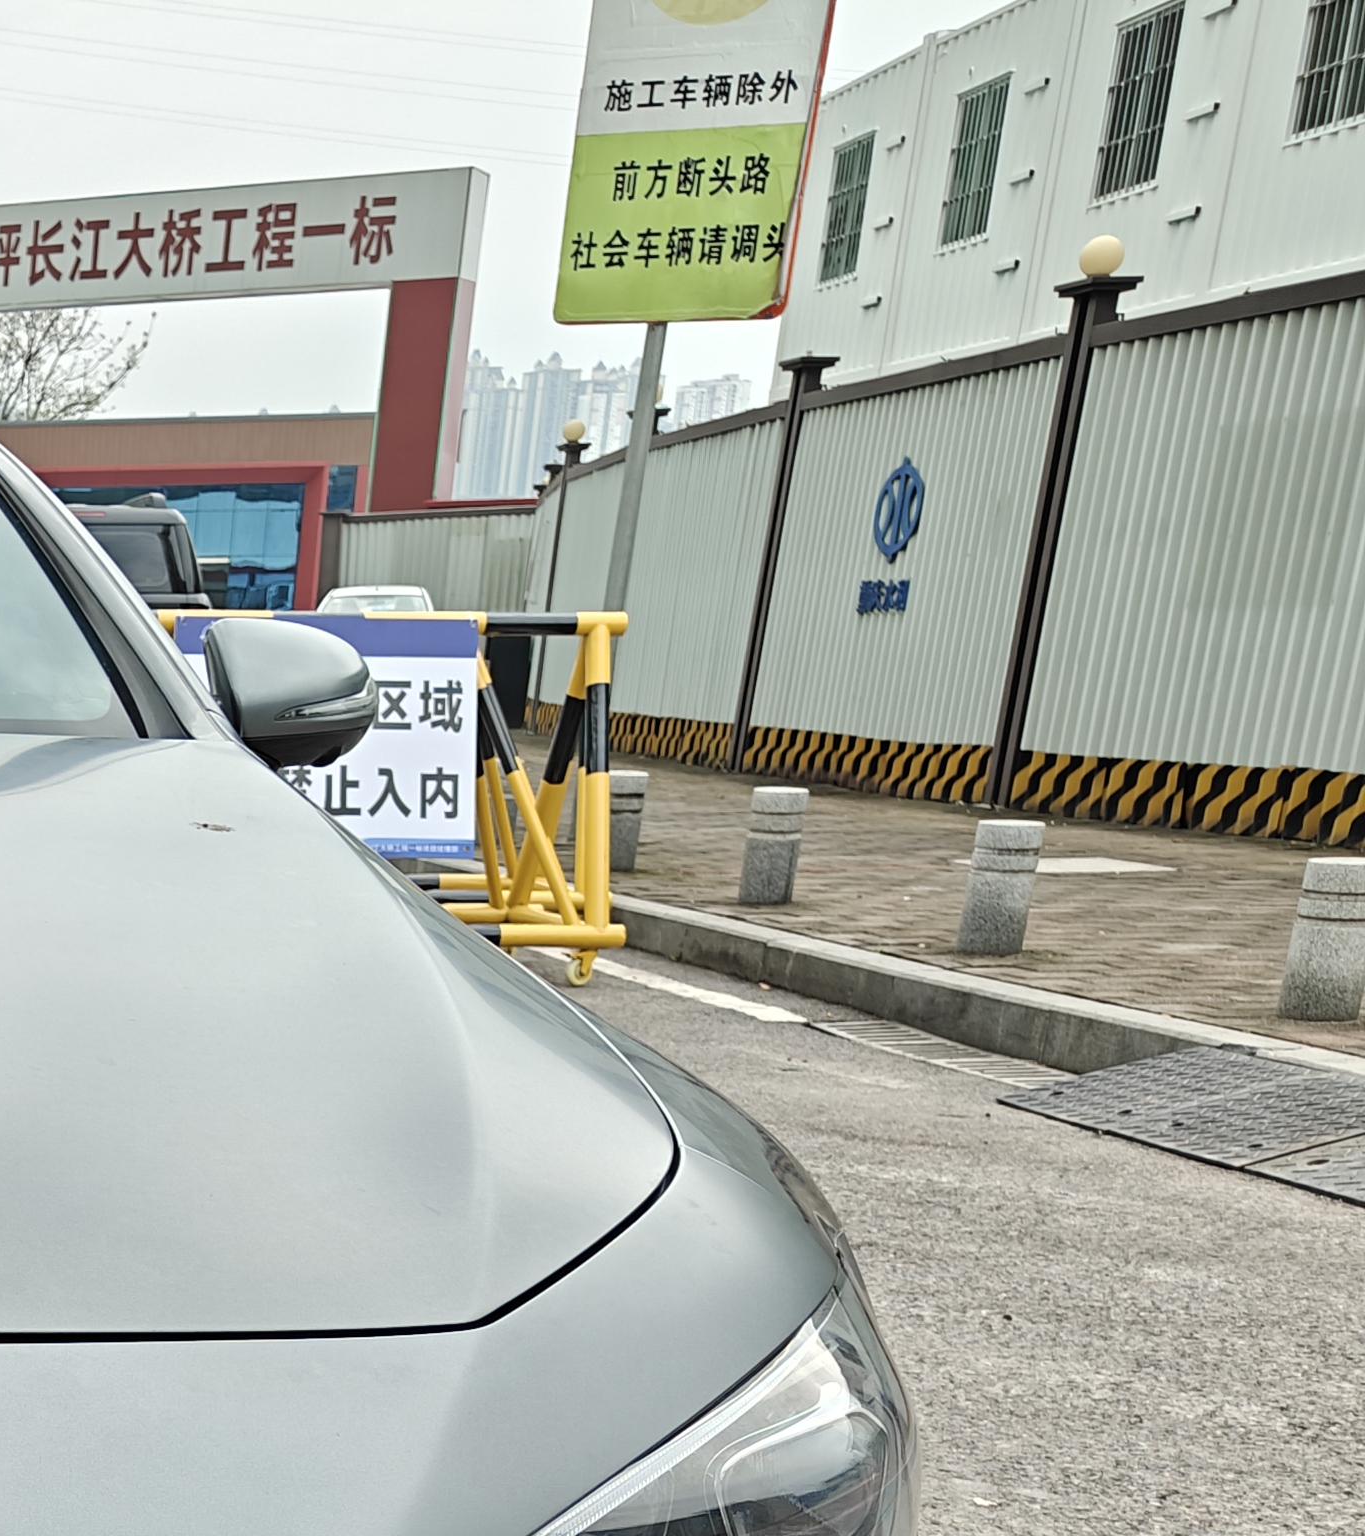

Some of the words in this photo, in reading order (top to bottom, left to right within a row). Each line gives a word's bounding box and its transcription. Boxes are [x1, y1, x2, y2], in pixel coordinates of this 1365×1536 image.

[604, 69, 799, 112] 施工车辆除外
[613, 153, 771, 201] 前方断头路
[570, 222, 787, 271] 社会车辆请调头
